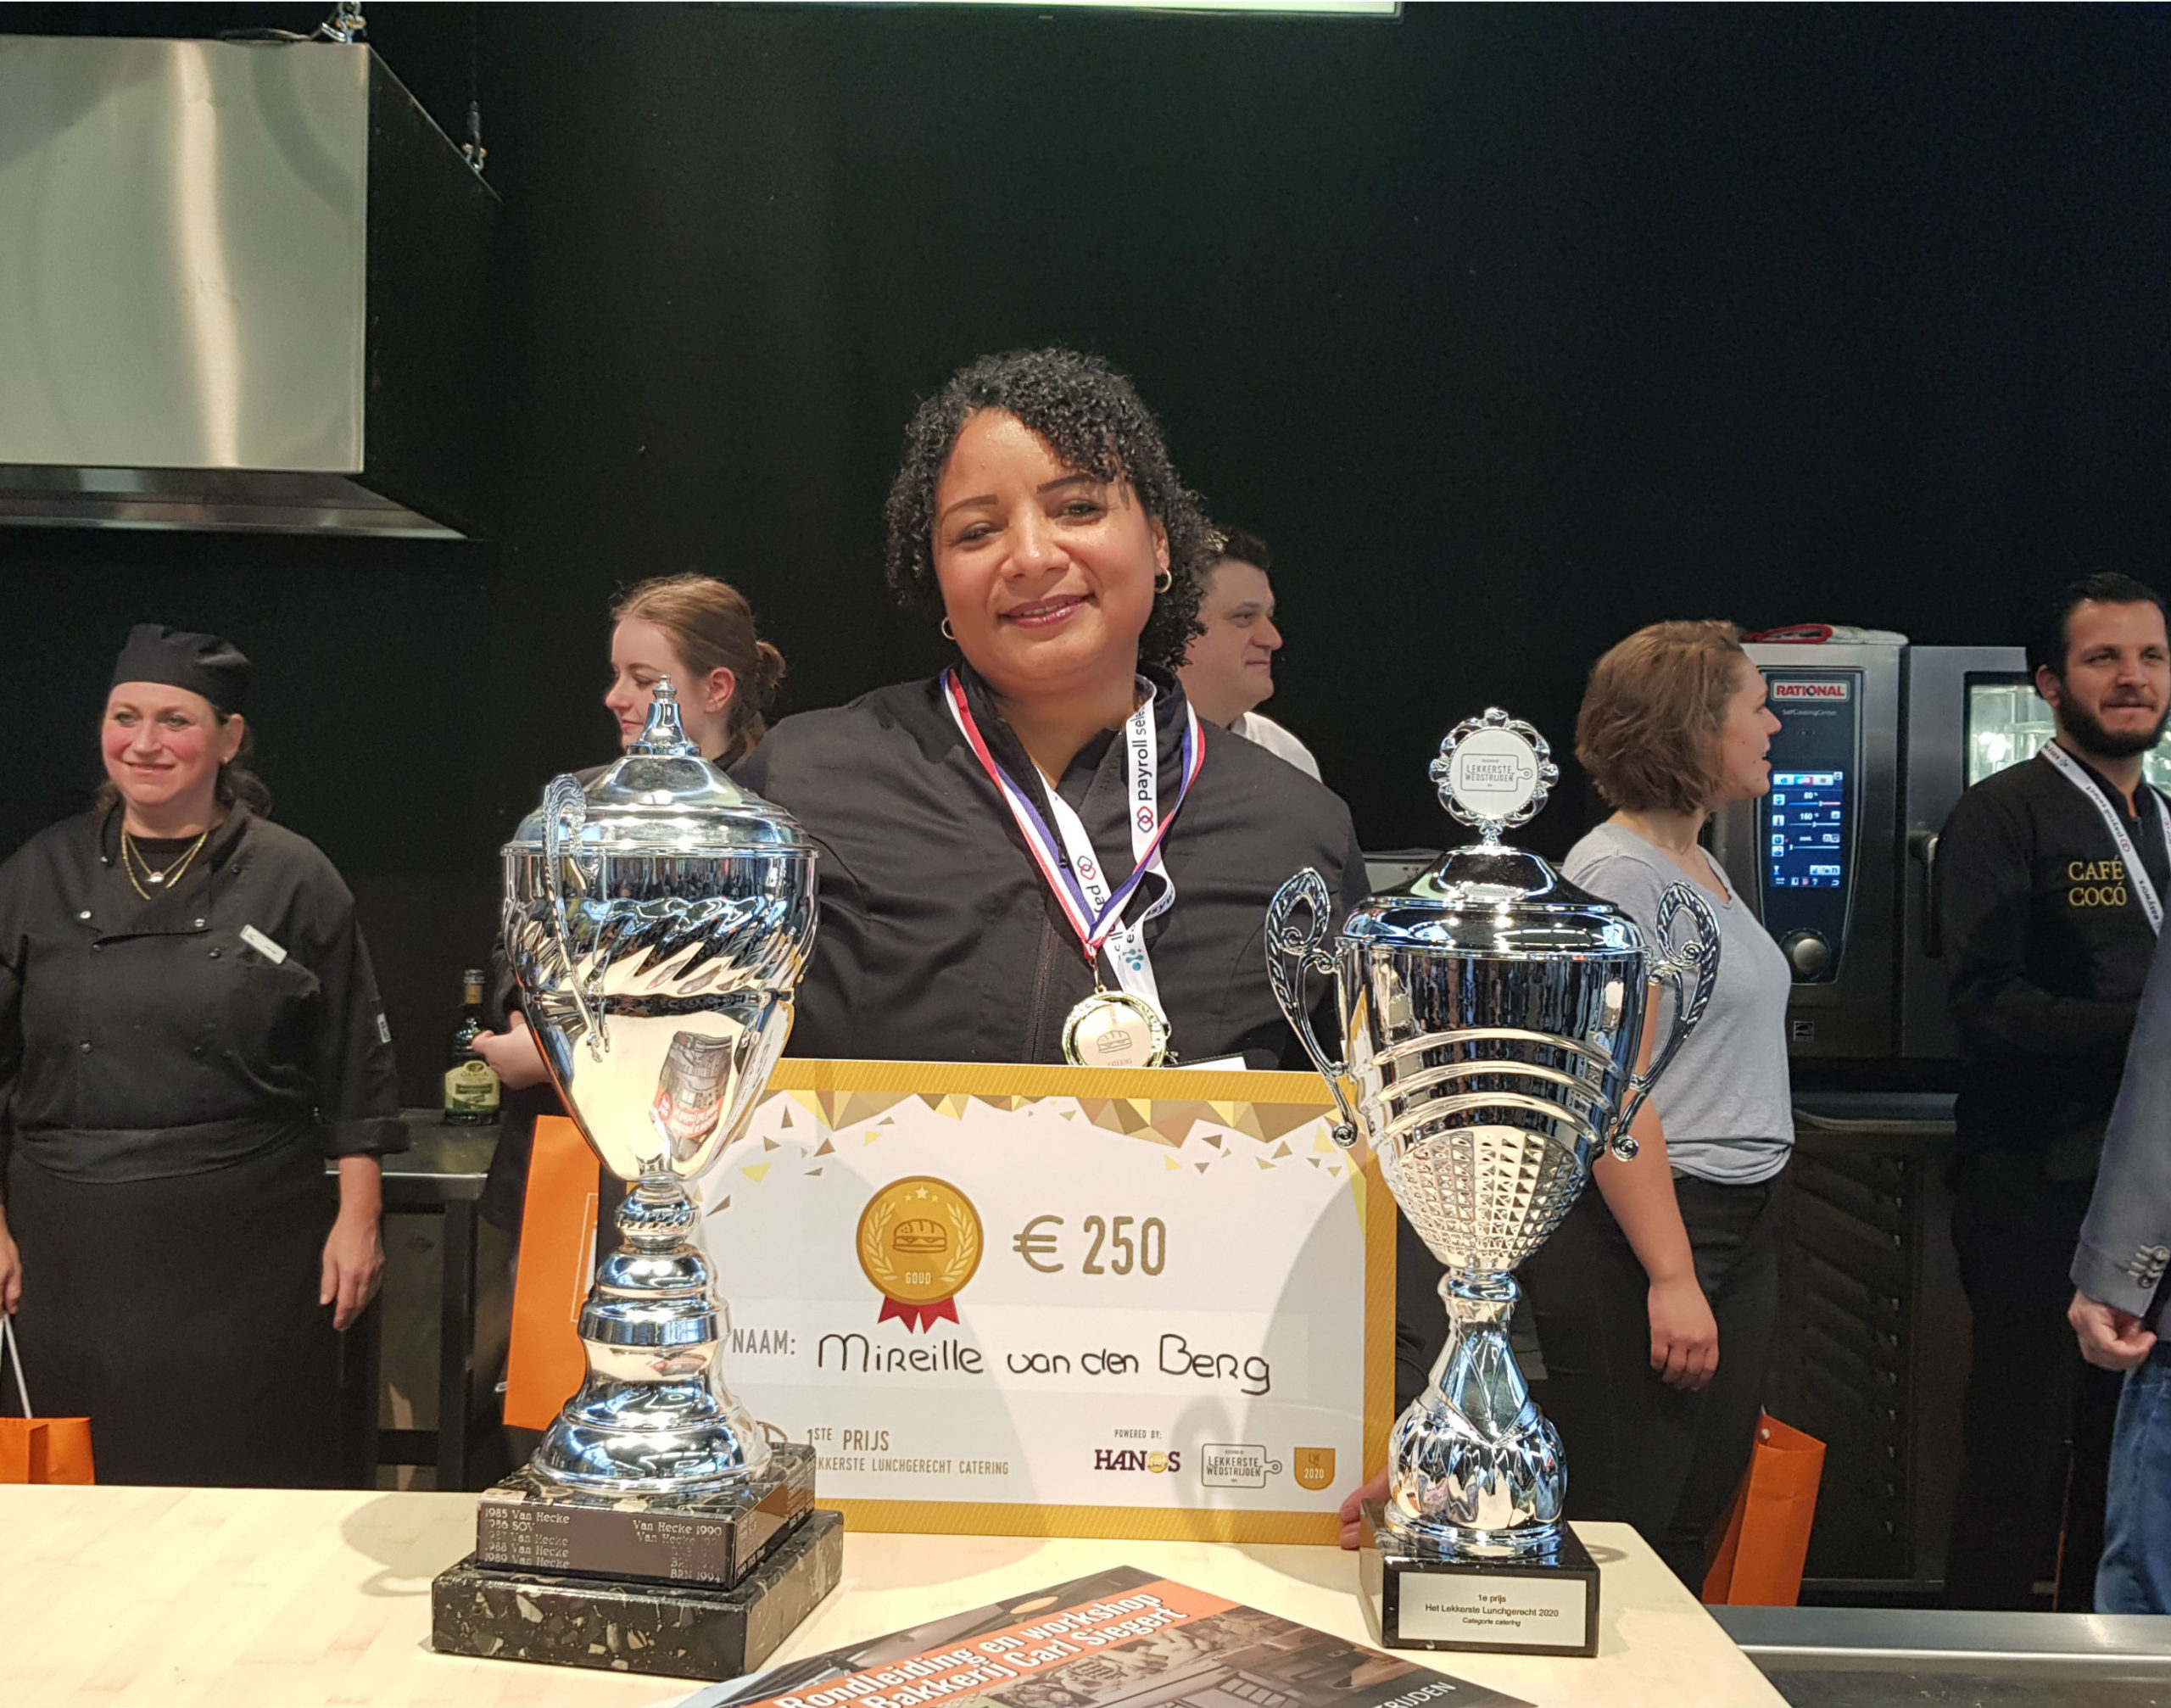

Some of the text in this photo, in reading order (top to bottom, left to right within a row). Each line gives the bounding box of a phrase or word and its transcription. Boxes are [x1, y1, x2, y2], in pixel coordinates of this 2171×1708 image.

[1776, 684, 1845, 696] RATIONAL
[1132, 740, 1152, 801] payroll
[1466, 764, 1512, 773] LEKKERSTE
[2068, 855, 2125, 881] CAFÉ
[2068, 882, 2128, 907] COCÓ
[1081, 1215, 1165, 1276] 250
[905, 1271, 932, 1285] GOUD
[733, 1329, 796, 1355] NAAM:
[1007, 1354, 1070, 1374] van
[1081, 1348, 1139, 1375] den
[806, 1428, 890, 1451] 1STE PRIJS
[1114, 1429, 1162, 1439] POWERED BY:
[818, 1457, 1009, 1475] KKERSTE LUNCHGERECHT CATERING
[1208, 1455, 1259, 1467] LEKKERSTE
[1207, 1465, 1261, 1476] WEDSTRIJDEN
[1303, 1468, 1325, 1479] 2020
[485, 1507, 570, 1524] 1985 Van Hecke
[486, 1519, 508, 1530] 986
[633, 1520, 723, 1536] Van Hecke 1990
[637, 1531, 657, 1543] Van
[485, 1542, 569, 1558] 988 Van Hecke
[511, 1555, 532, 1566] Van
[536, 1557, 570, 1569] Hecke
[1490, 1595, 1506, 1604] prijs
[1442, 1605, 1480, 1613] Lekkerste
[1482, 1606, 1537, 1616] Lunchgerecht
[1539, 1609, 1559, 1617] 2020
[1463, 1617, 1521, 1627] Categorie catering
[773, 1593, 1164, 1708] Rondleiding en workshop
[861, 1607, 1190, 1708] Bakkerij Carl Siegert
[1370, 1682, 1457, 1708] RIJDEN
